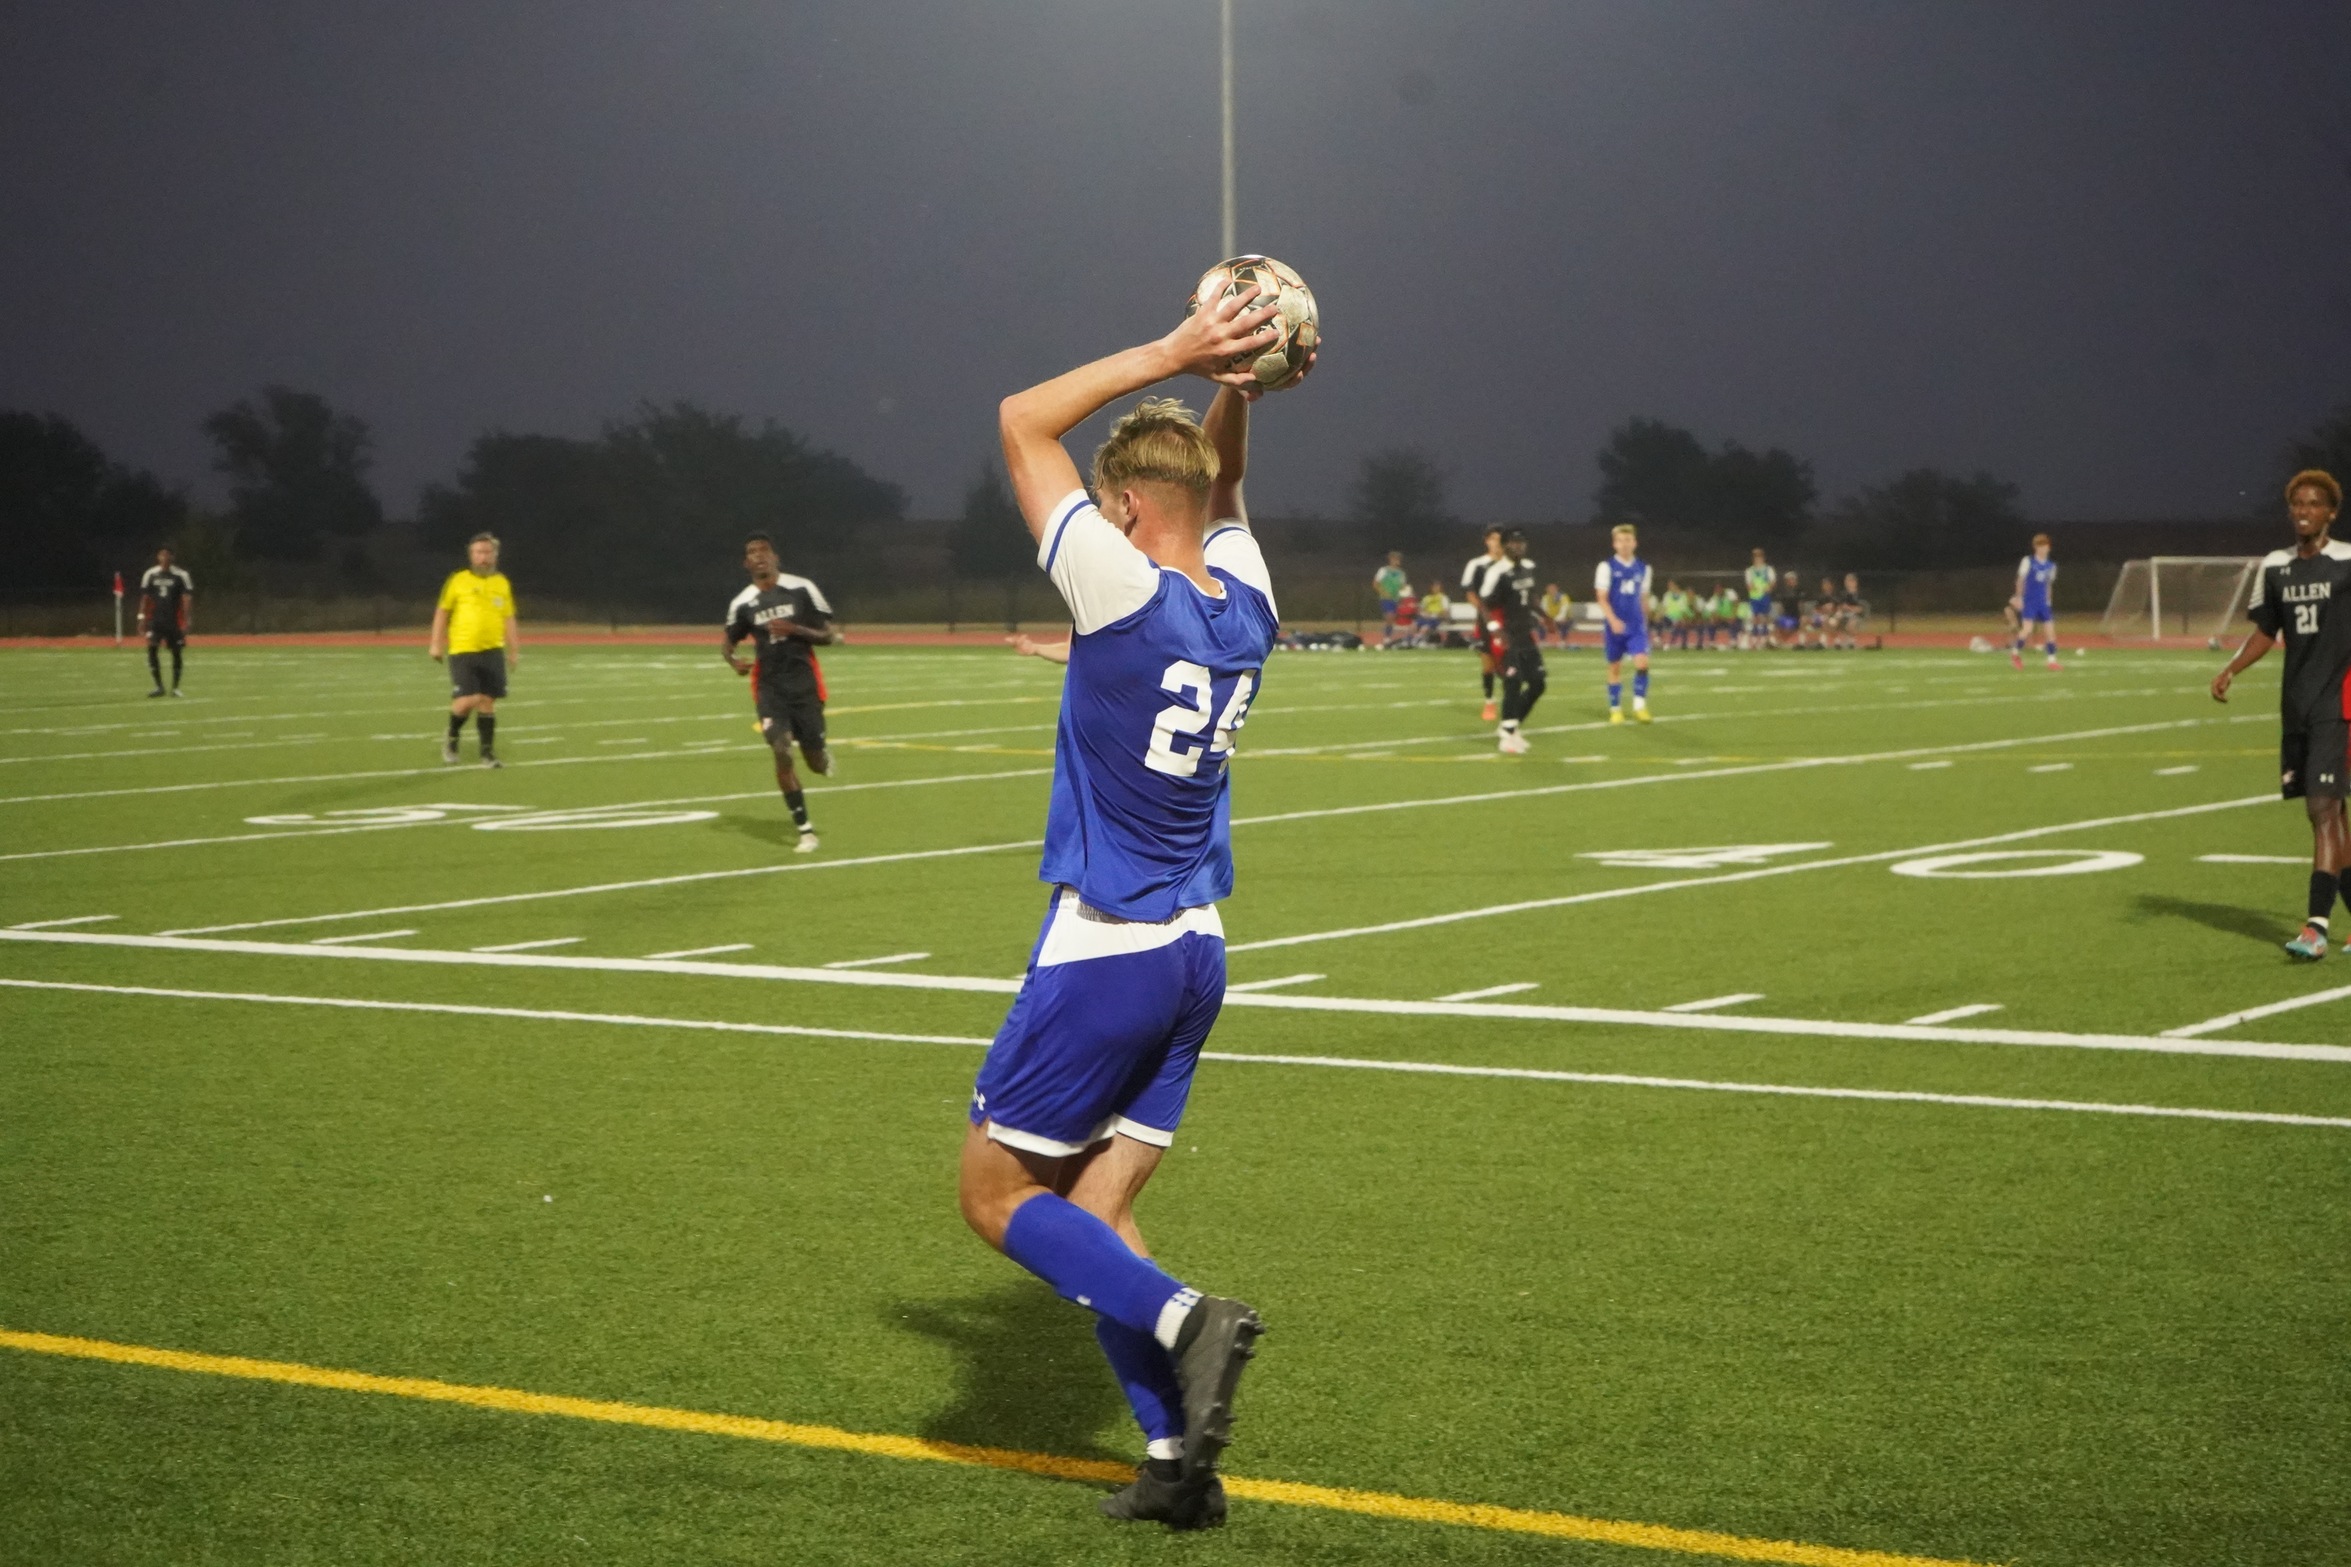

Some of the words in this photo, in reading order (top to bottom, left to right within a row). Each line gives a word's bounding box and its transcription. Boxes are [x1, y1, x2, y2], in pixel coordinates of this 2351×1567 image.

[2282, 582, 2331, 603] ALLEN
[2294, 604, 2319, 634] 21
[1144, 660, 1258, 777] 24
